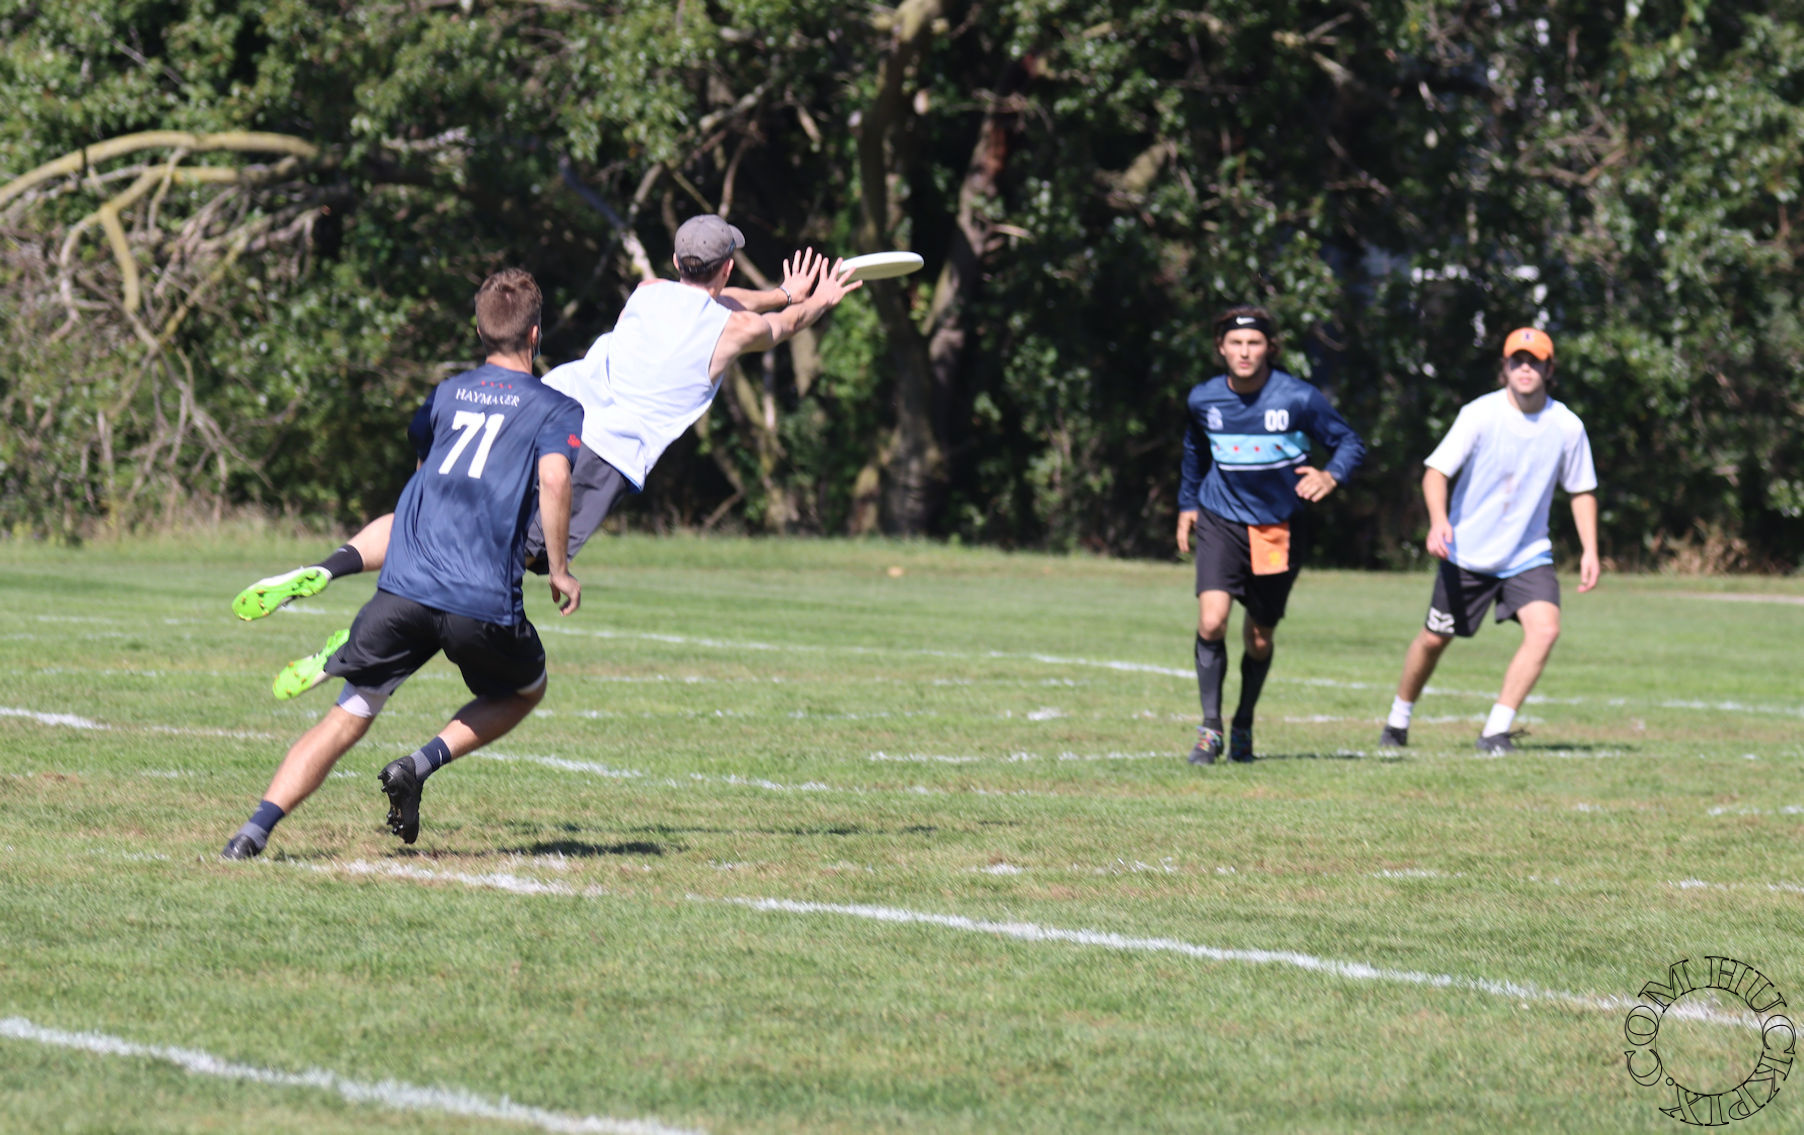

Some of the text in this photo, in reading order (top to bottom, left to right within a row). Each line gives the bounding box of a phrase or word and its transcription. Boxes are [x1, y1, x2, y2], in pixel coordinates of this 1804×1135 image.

[1264, 408, 1290, 432] 00
[438, 410, 505, 479] 71
[1426, 606, 1456, 634] 52
